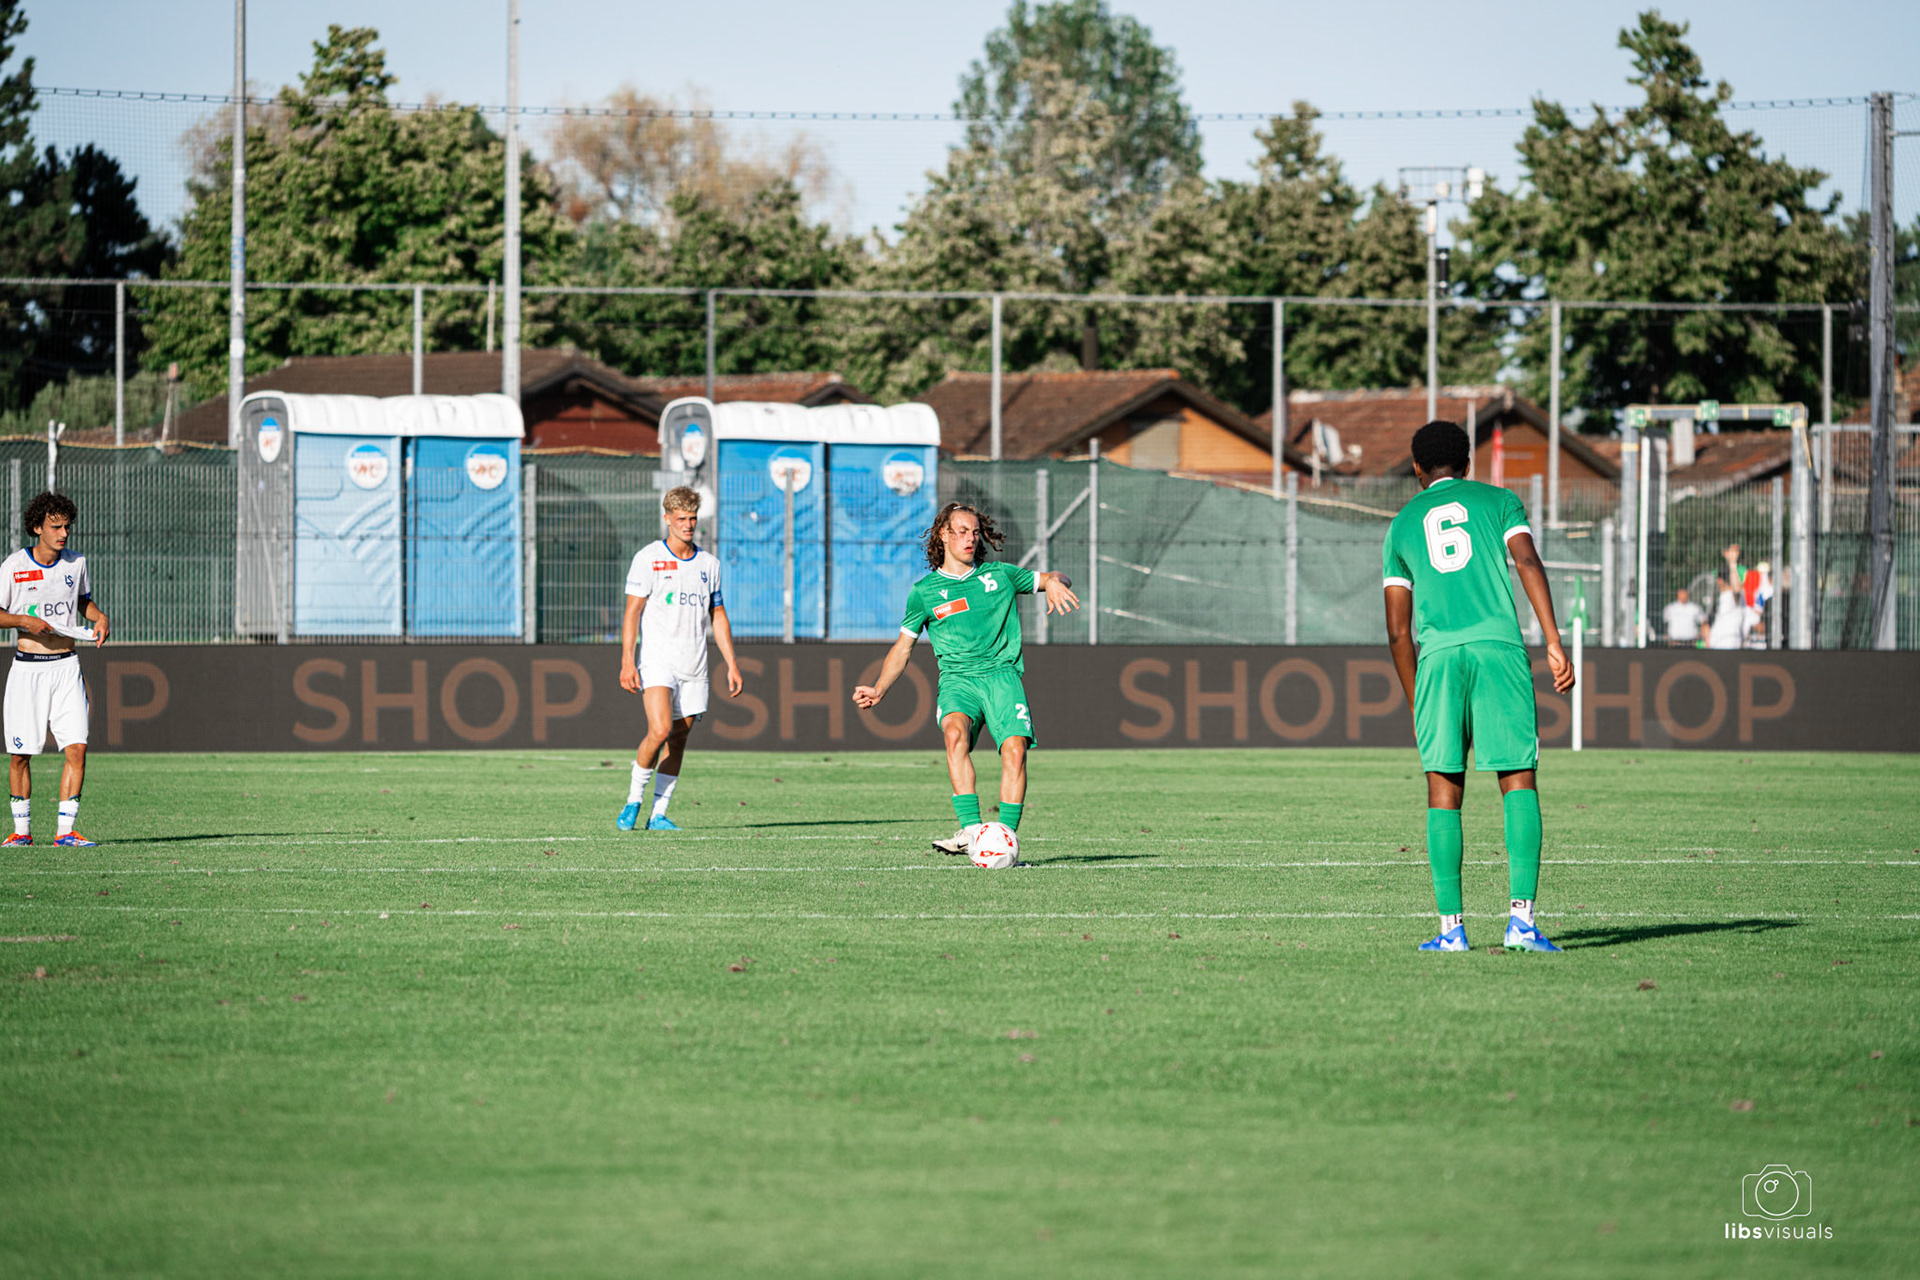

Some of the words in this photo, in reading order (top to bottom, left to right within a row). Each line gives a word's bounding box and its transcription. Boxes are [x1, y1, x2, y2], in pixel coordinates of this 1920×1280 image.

[1423, 501, 1473, 574] 6
[44, 600, 75, 617] BCV
[679, 592, 707, 607] BCV
[292, 657, 593, 743] SHOP
[711, 657, 932, 741] SHO
[1119, 657, 1404, 741] SHOP
[1530, 660, 1796, 743] SHOP
